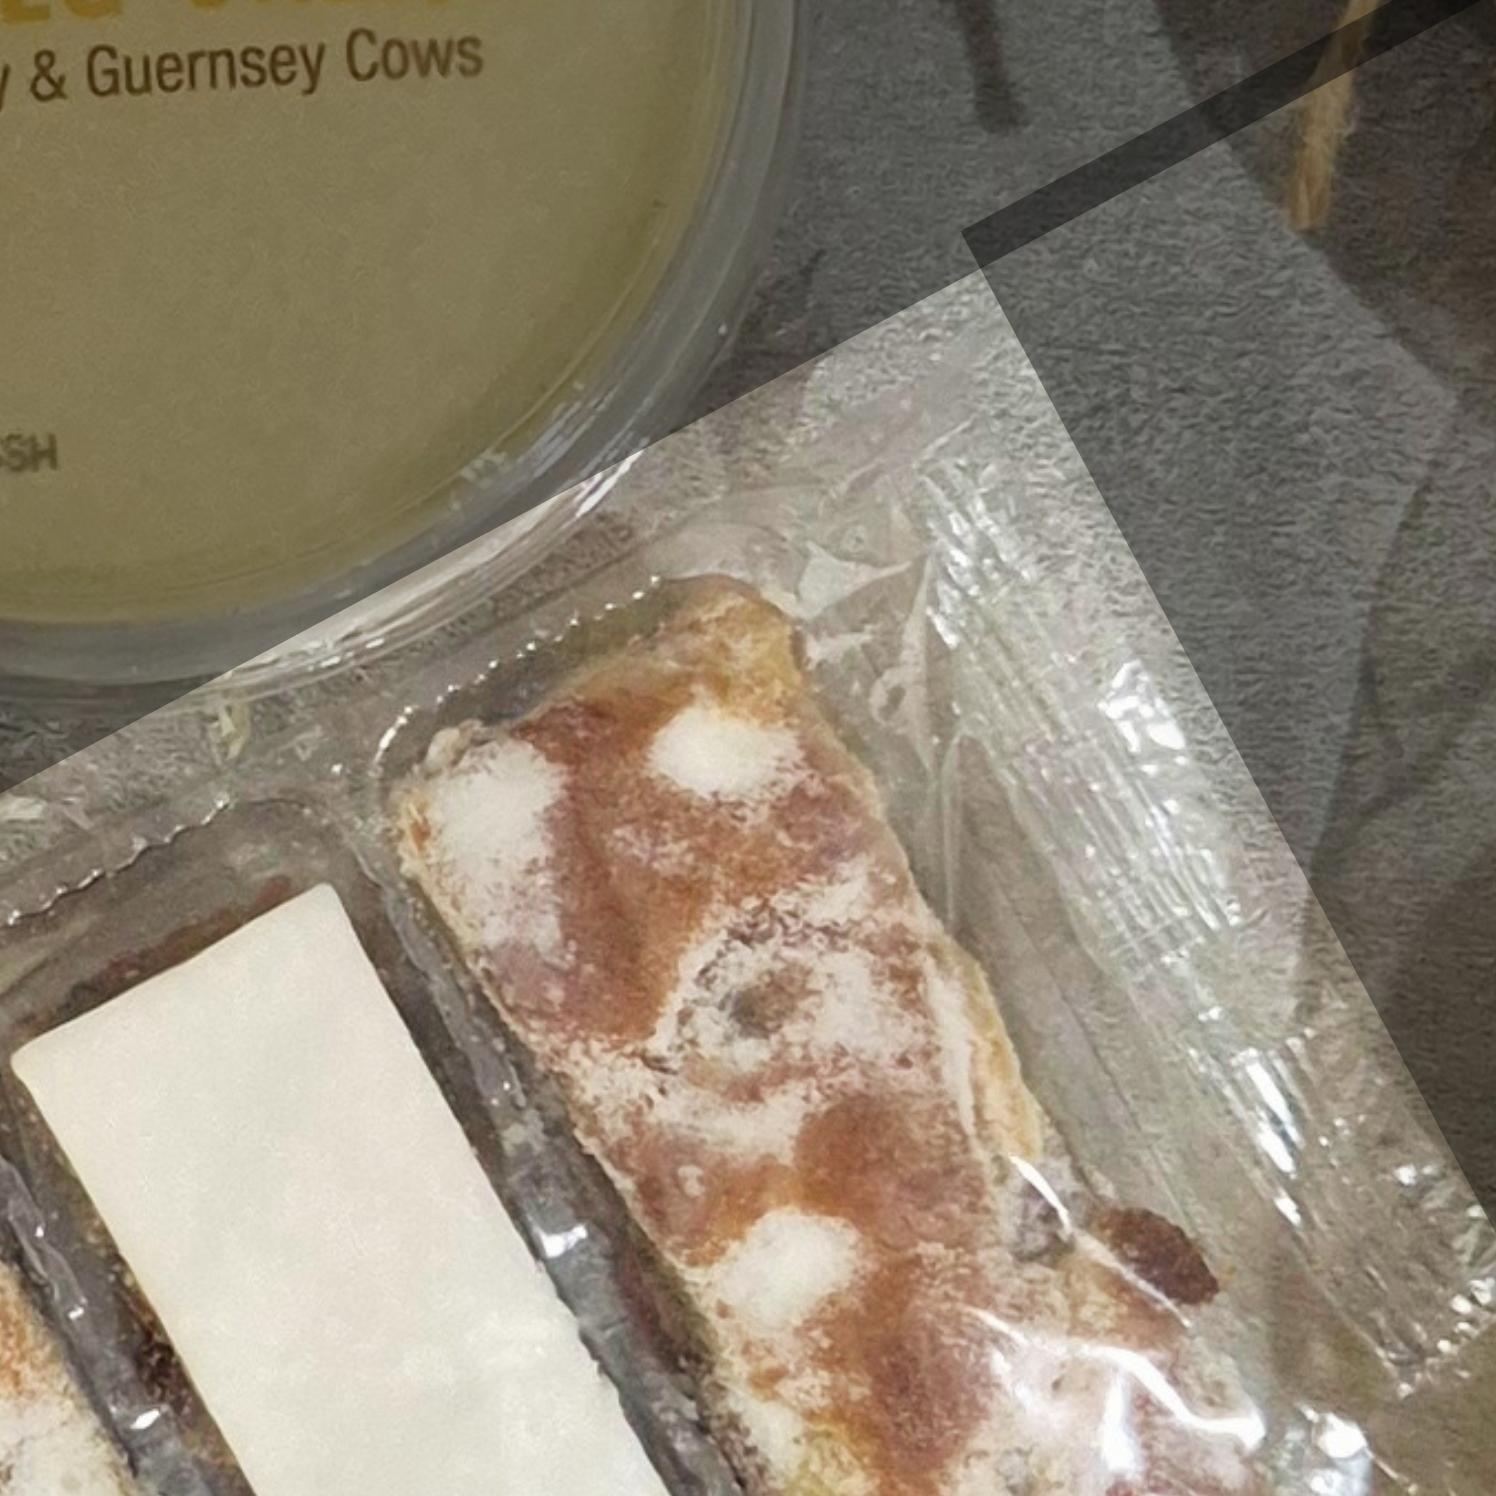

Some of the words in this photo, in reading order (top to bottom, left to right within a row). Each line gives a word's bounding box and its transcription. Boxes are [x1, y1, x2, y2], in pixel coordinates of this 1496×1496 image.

[29, 48, 69, 103] &
[86, 42, 326, 97] Guernsey
[345, 27, 485, 83] Cows
